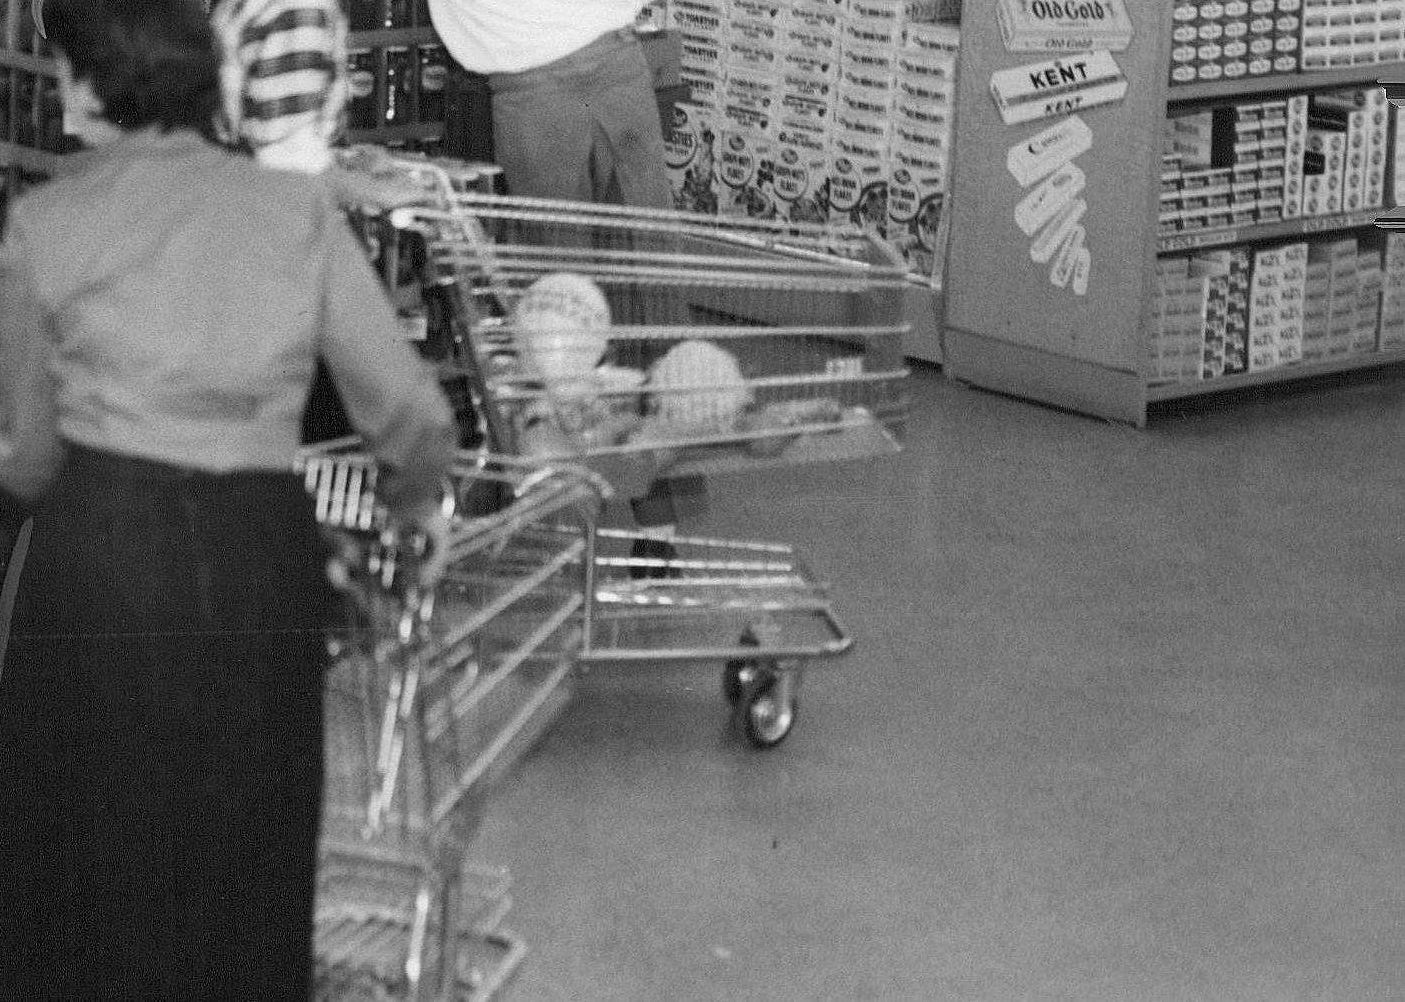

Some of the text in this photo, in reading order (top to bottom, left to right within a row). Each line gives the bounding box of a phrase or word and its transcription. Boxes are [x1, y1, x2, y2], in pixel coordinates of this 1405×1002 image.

[1031, 0, 1106, 21] Old Gold
[1029, 61, 1087, 90] KENT
[1044, 96, 1084, 115] KENT
